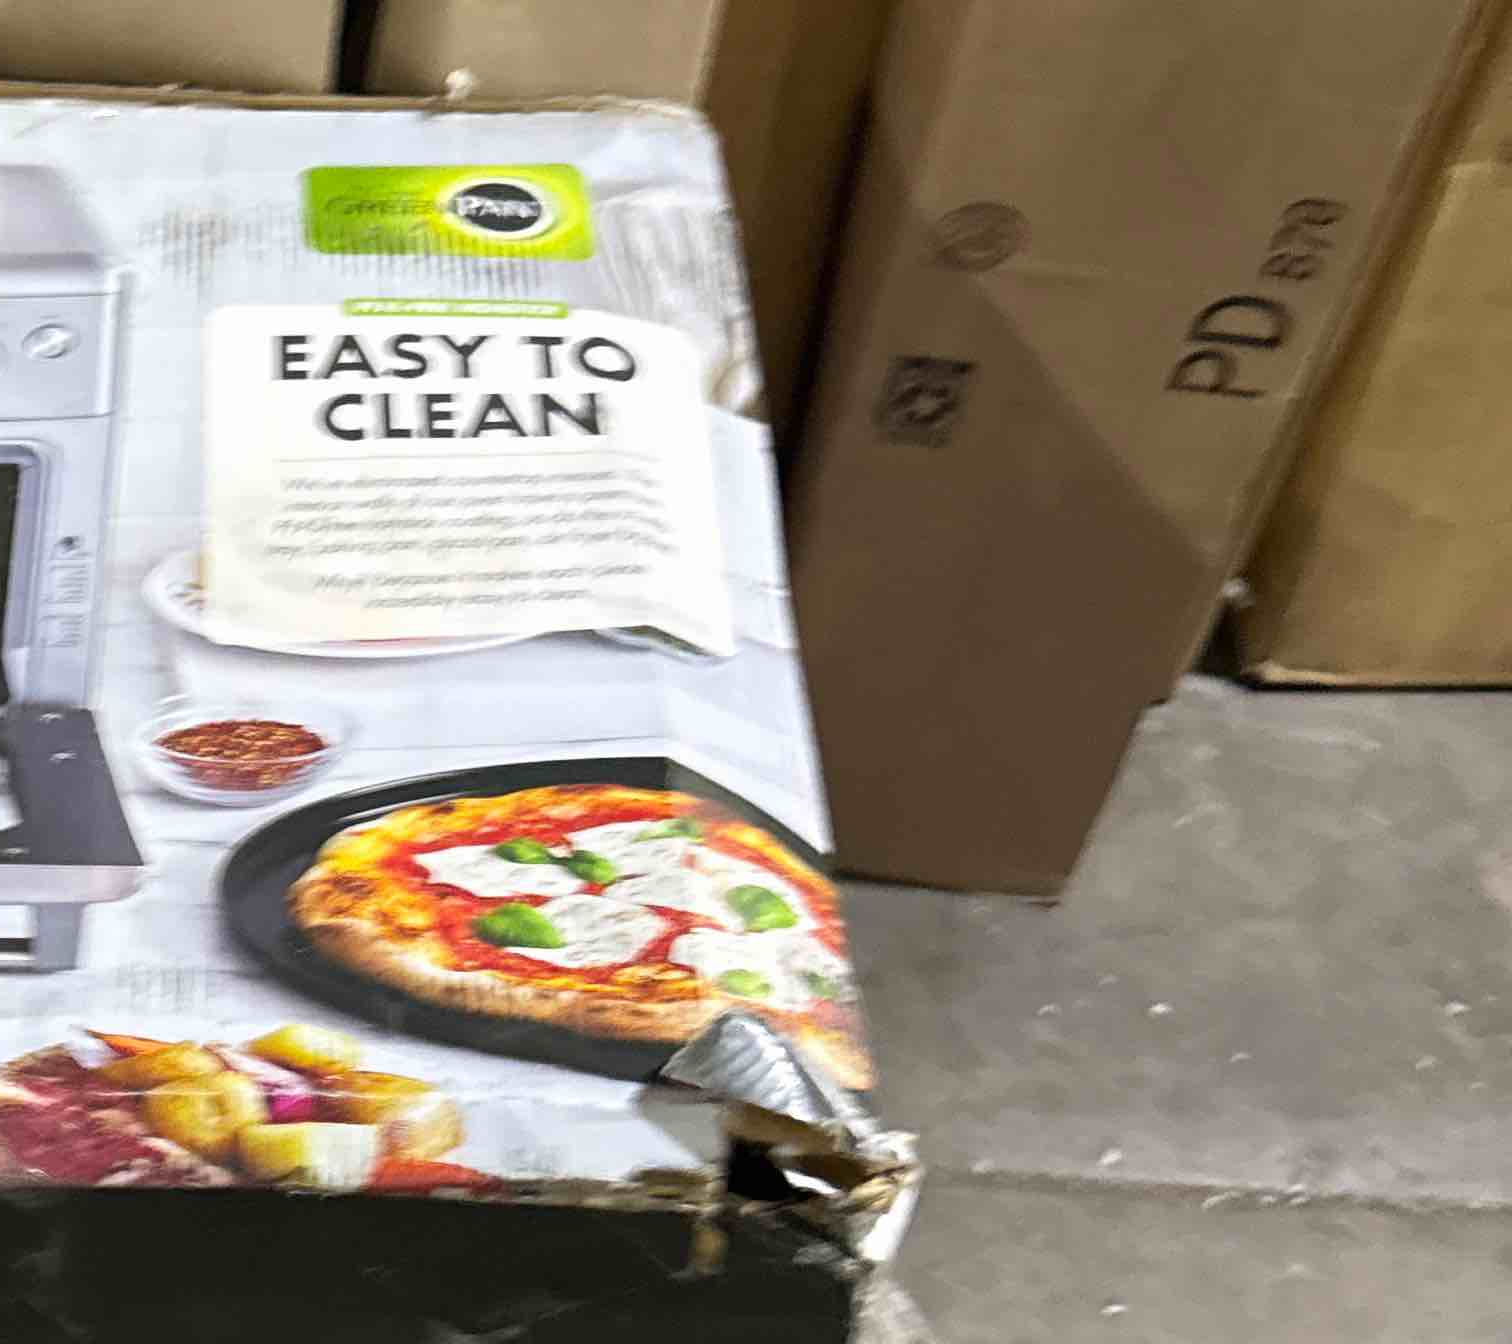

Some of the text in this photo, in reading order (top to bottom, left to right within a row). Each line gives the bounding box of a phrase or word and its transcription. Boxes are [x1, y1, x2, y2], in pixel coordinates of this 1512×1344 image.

[273, 333, 636, 382] EASY TO
[1164, 296, 1294, 399] PD
[315, 392, 602, 441] CLEAN
